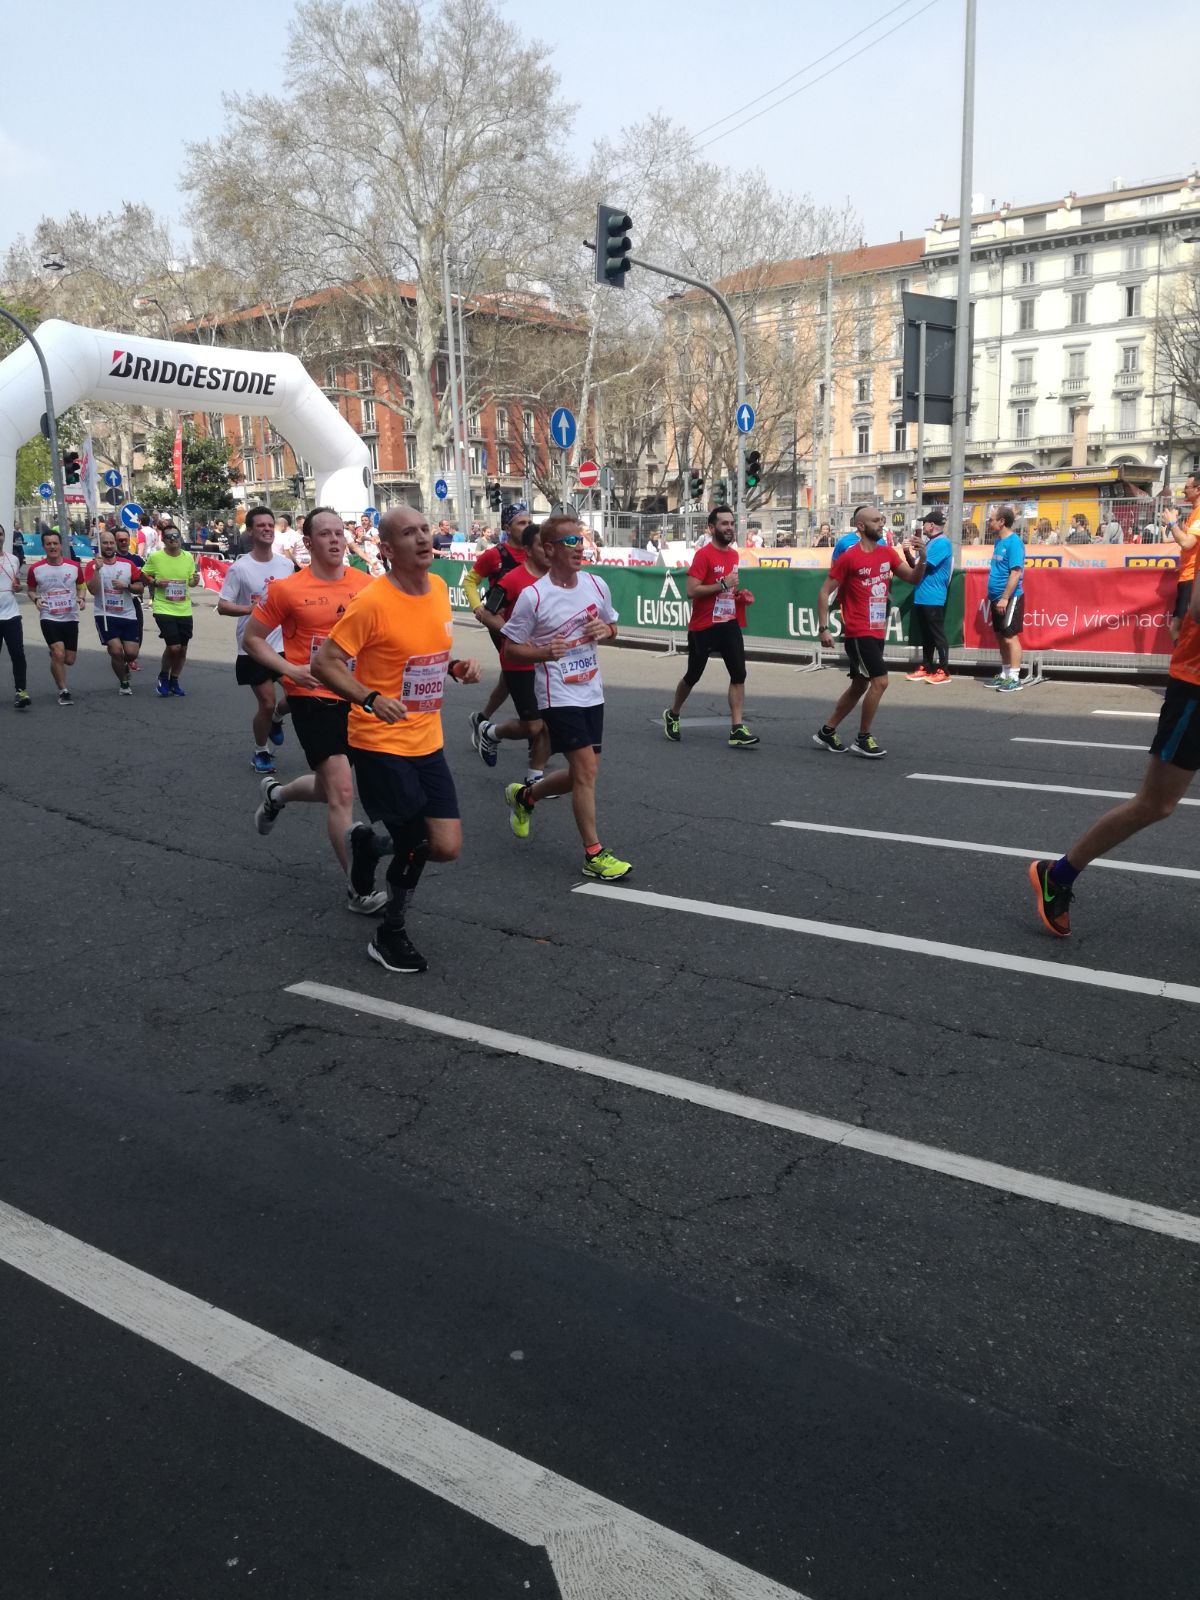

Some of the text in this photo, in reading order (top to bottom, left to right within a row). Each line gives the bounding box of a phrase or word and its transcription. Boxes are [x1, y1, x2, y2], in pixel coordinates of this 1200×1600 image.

[109, 350, 276, 395] BRIDGESTONE
[859, 567, 872, 575] sky
[637, 595, 692, 627] LEVISSIN
[1023, 608, 1069, 628] ctive
